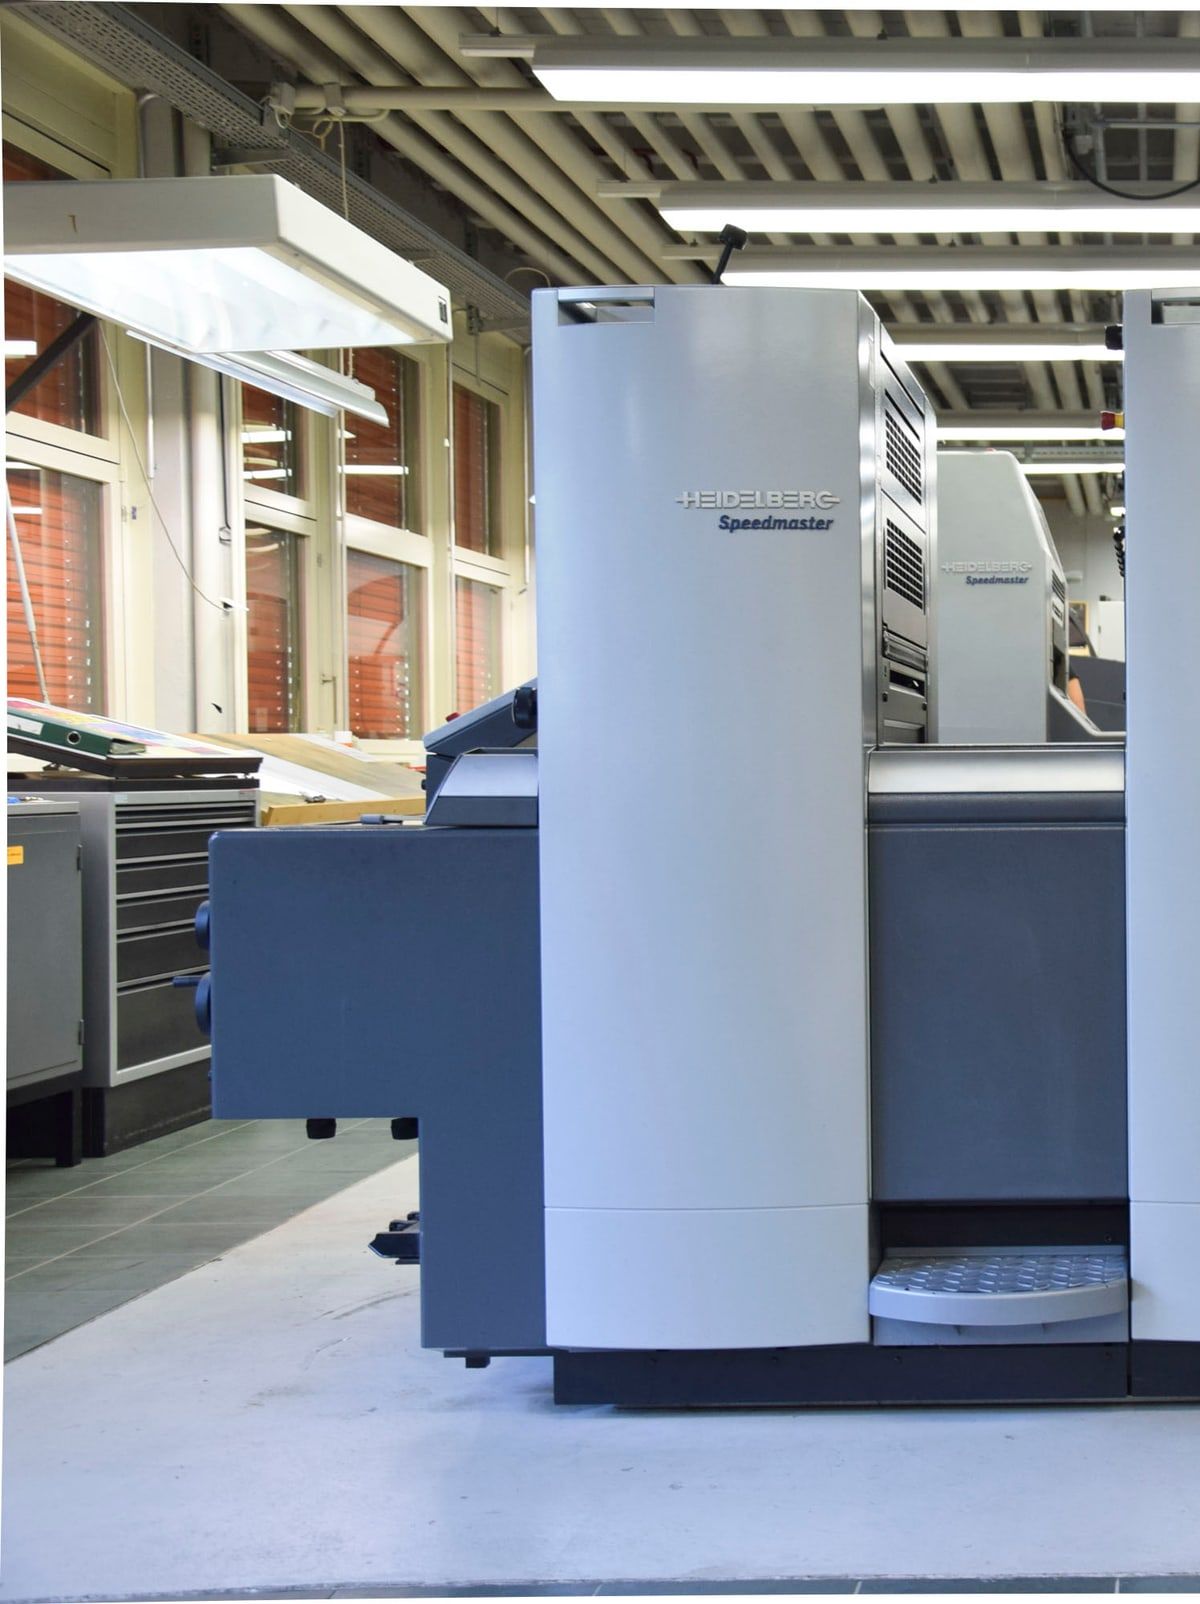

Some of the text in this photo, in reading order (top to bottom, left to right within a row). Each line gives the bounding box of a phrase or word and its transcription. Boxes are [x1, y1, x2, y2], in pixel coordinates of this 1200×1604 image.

[676, 490, 840, 510] HEIDELBERG
[718, 514, 834, 533] Speedmaster
[941, 561, 1032, 573] HEIDELBERG
[965, 575, 1029, 586] Speedmaster
